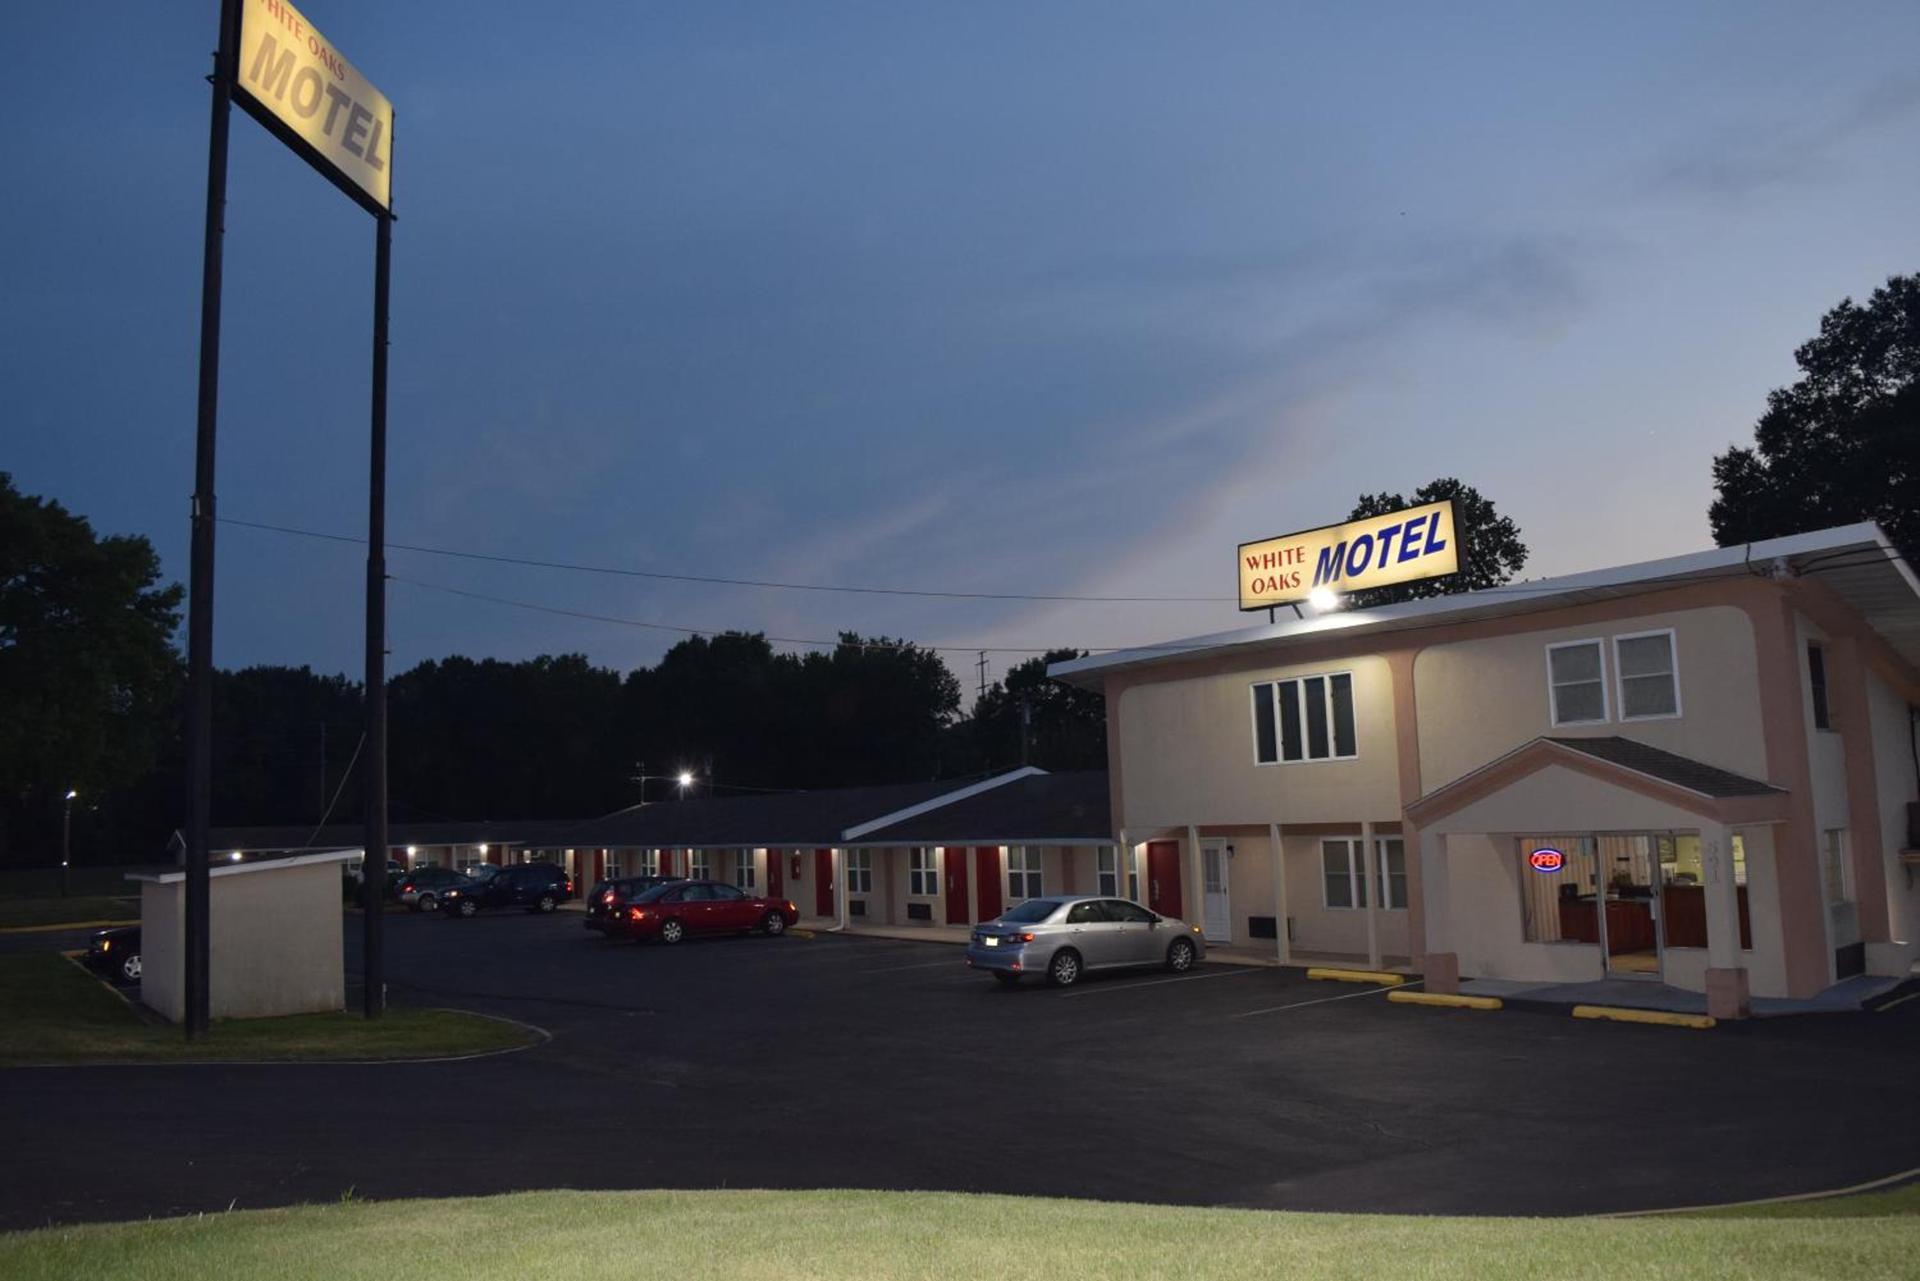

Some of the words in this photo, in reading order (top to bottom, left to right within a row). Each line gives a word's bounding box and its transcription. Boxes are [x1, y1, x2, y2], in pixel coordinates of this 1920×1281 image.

[261, 0, 304, 42] HITE
[308, 36, 345, 81] OAKS
[249, 32, 385, 172] MOTEL
[1246, 546, 1306, 571] WHITE
[1312, 512, 1447, 587] MOTEL
[1251, 571, 1302, 595] OAKS
[1531, 854, 1561, 867] OPEN
